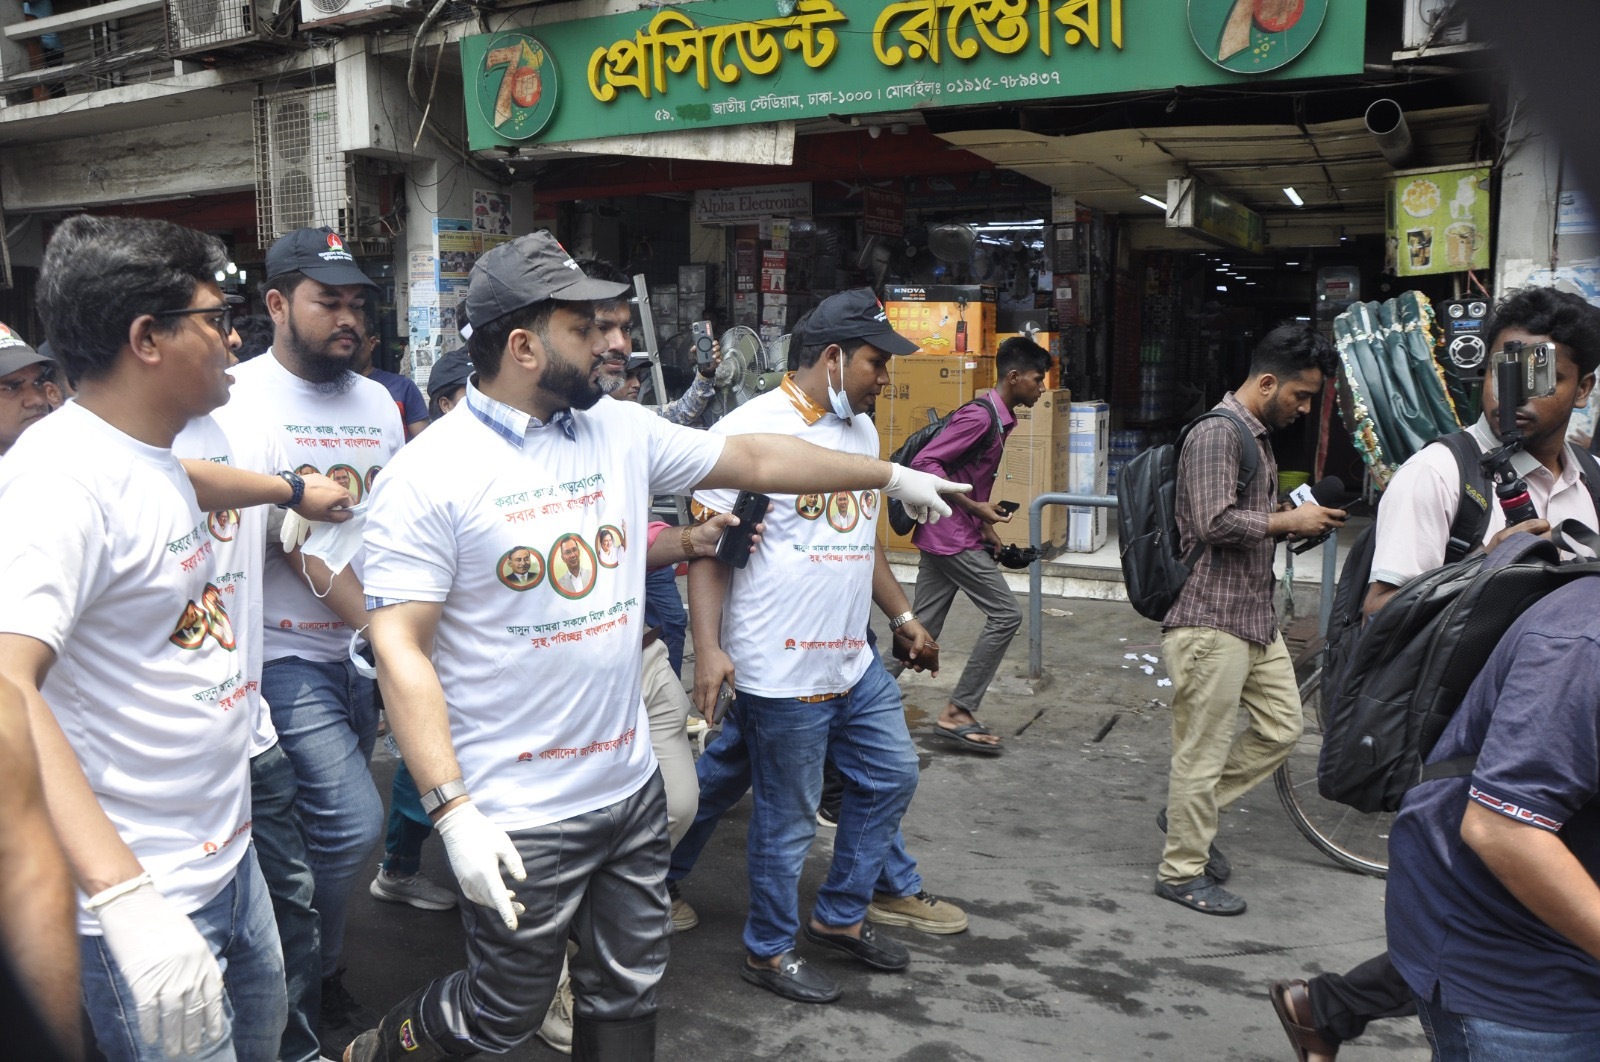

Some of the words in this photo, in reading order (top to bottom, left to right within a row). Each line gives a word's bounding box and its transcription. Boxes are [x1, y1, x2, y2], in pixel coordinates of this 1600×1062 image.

[586, 9, 849, 103] প্রেসিডেন্ট
[654, 108, 675, 122] ৫৯,
[712, 97, 746, 115] জাতীয়
[750, 94, 804, 112] স্টেডিয়াম,
[806, 90, 872, 106] ঢাকা-১০০০
[946, 71, 1061, 93] ০১৯১৫-৭৮৯৪৩৭
[700, 198, 736, 214] Alpha
[739, 193, 809, 211] Electronics
[284, 424, 313, 434] করবো
[315, 425, 338, 436] কাজ,
[340, 425, 366, 436] গড়বো
[369, 426, 382, 437] দেশ
[1069, 419, 1085, 428] EE
[295, 437, 318, 448] সবার
[319, 438, 342, 448] আগে
[344, 438, 381, 449] বাংলাদেশ
[494, 492, 528, 509] করবো
[505, 508, 536, 524] সবার
[540, 501, 564, 515] আগে
[566, 490, 606, 509] বাংলাদেশ
[506, 624, 530, 637] আসুন
[533, 621, 560, 634] আমরা
[563, 615, 588, 629] সকলে
[589, 610, 605, 622] মিলে
[607, 602, 624, 617] একটি
[551, 629, 583, 644] পরিচ্ছন্ন
[585, 621, 617, 637] বাংলাদেশ
[539, 747, 577, 759] বাংলাদেশ
